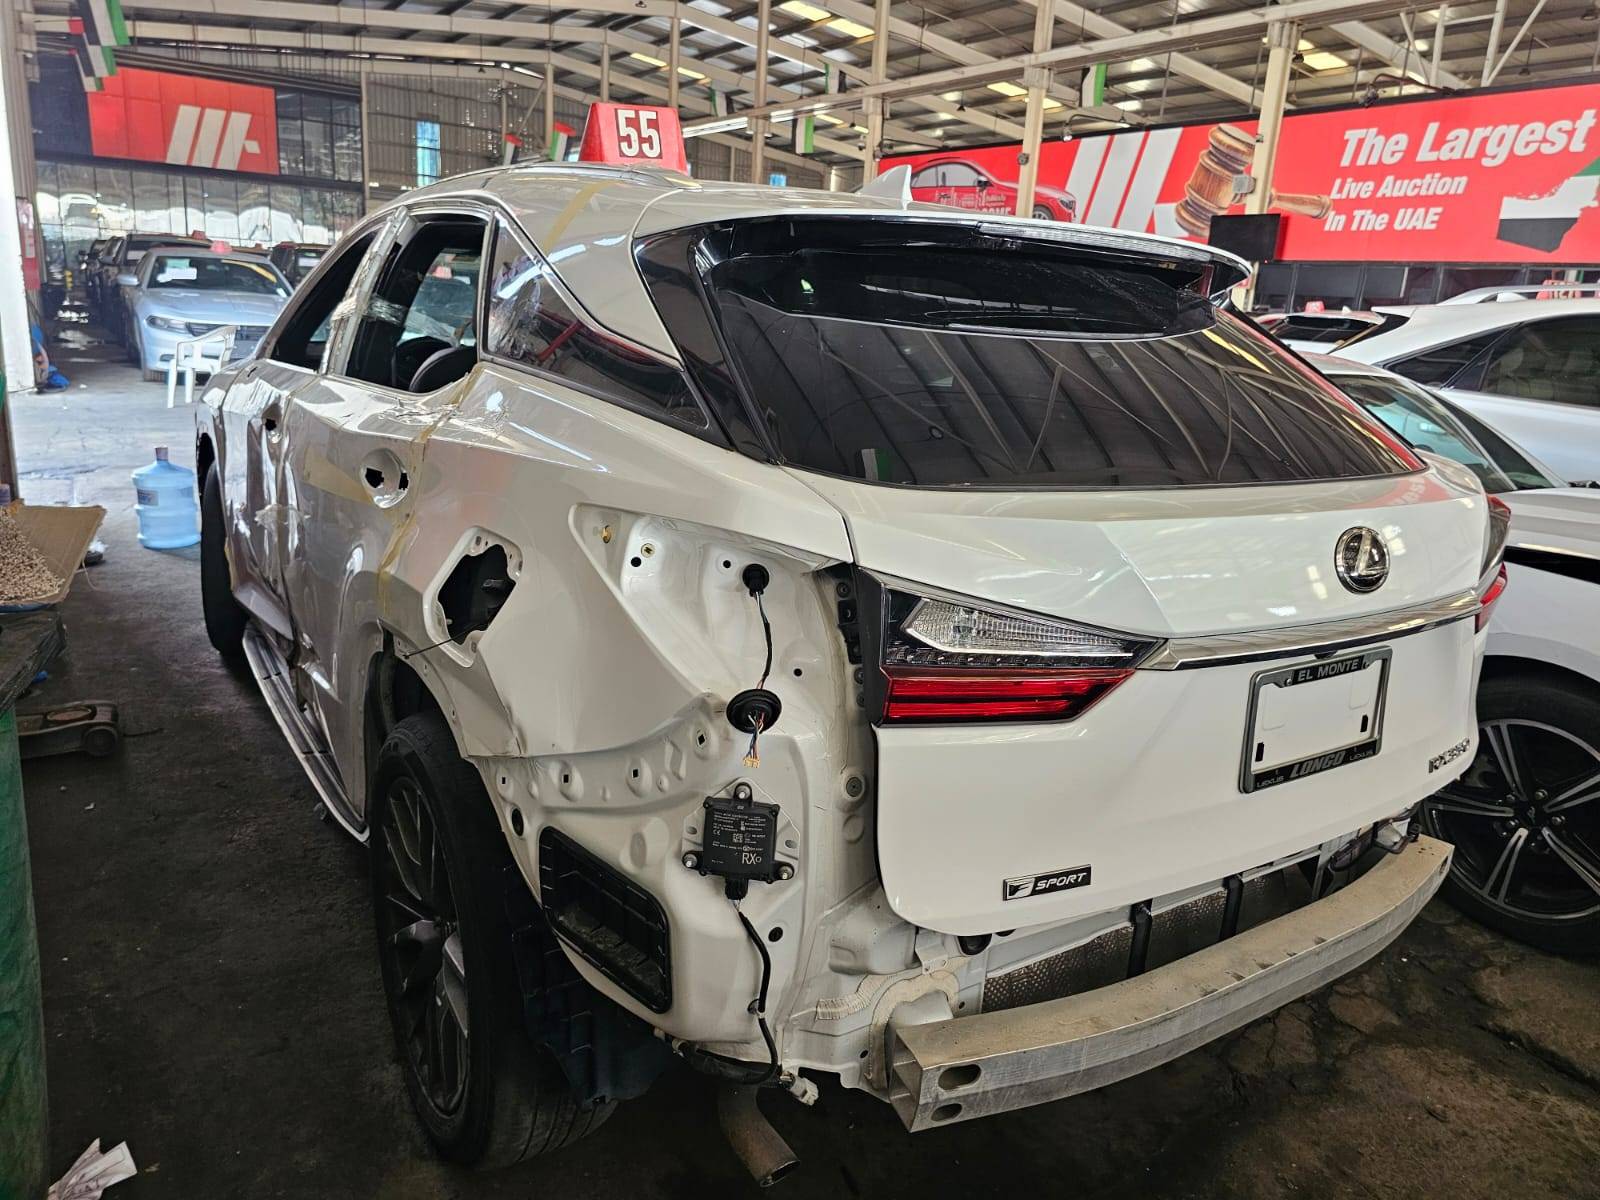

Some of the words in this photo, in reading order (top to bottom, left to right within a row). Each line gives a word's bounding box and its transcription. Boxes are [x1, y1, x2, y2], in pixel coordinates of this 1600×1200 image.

[617, 109, 660, 157] 55
[1340, 128, 1408, 167] The
[1416, 109, 1597, 167] Largest
[1330, 177, 1374, 199] Live
[1376, 173, 1467, 198] Auction
[1324, 209, 1346, 231] In
[1351, 209, 1389, 231] The
[1393, 207, 1443, 230] UAE
[1297, 670, 1313, 682] EL
[1317, 660, 1359, 676] MONTE
[1289, 751, 1346, 778] LONGO
[1035, 872, 1087, 890] SPORT
